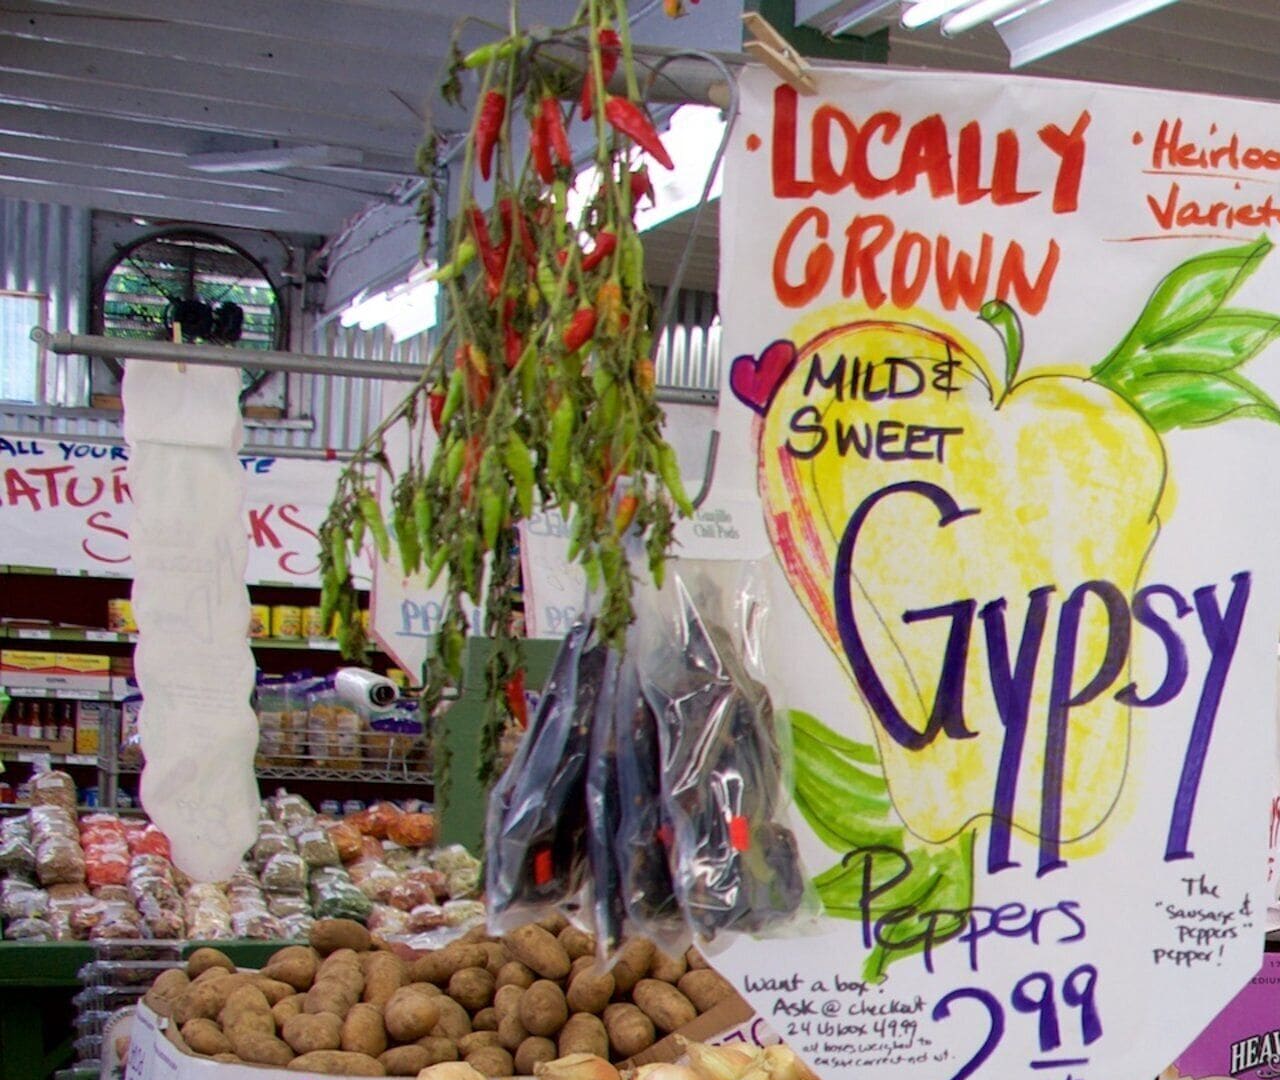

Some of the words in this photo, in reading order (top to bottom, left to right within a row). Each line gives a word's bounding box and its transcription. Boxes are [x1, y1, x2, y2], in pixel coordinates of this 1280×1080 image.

[772, 83, 1091, 213] LOCALLY
[771, 206, 1060, 315] GROWN
[803, 354, 924, 402] MILD
[59, 442, 129, 462] YOUR
[785, 406, 963, 483] SWEET
[842, 845, 1086, 973] Peppers
[1181, 873, 1220, 899] The
[811, 981, 830, 992] a
[834, 974, 889, 997] box?
[821, 1000, 841, 1017] @
